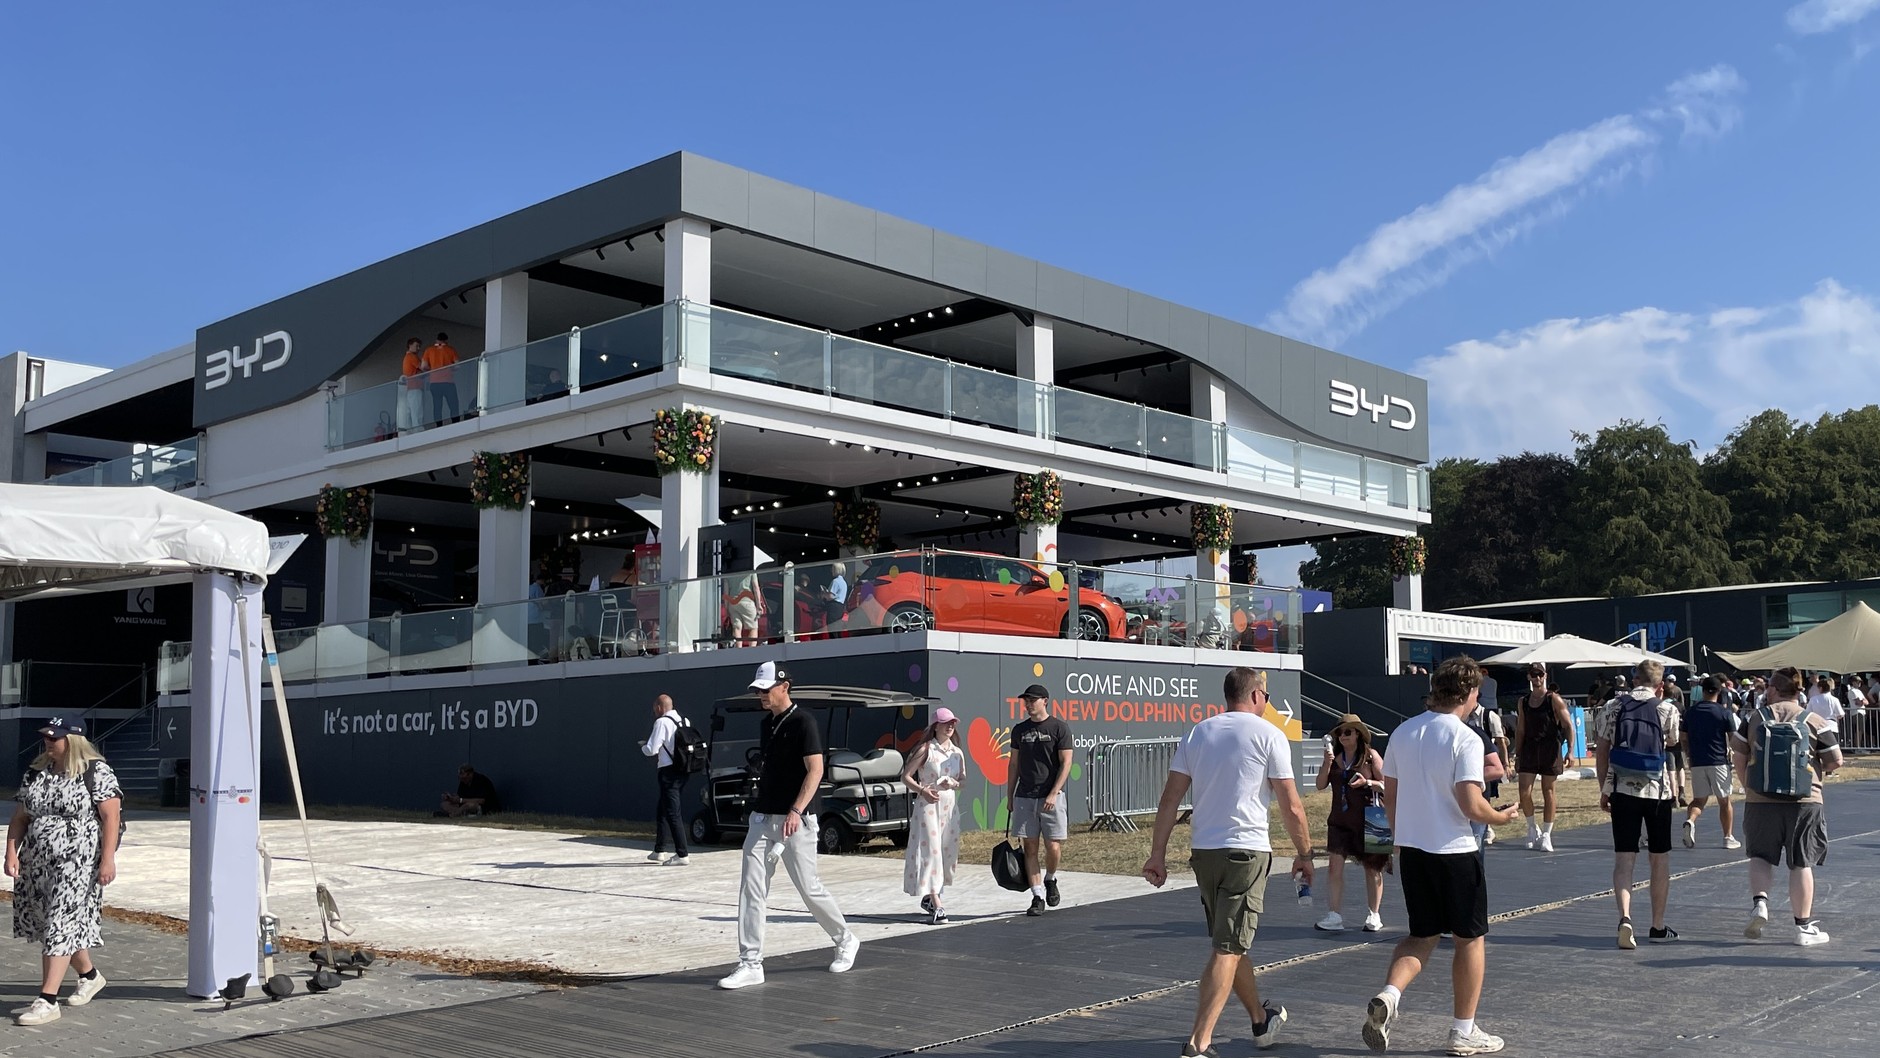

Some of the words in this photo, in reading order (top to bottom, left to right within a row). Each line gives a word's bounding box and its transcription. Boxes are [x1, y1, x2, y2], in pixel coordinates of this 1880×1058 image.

[206, 331, 292, 390] BYD
[1330, 379, 1416, 430] BYD
[375, 541, 438, 565] YD
[113, 616, 166, 625] YANGWANG
[1066, 672, 1122, 696] COME
[1126, 676, 1166, 697] AND
[1170, 677, 1198, 698] SEE
[323, 707, 349, 735] It’s
[352, 709, 382, 733] not
[385, 713, 397, 732] a
[402, 711, 435, 736] car,
[441, 701, 470, 730] It’s
[475, 709, 488, 729] a
[494, 698, 539, 728] BYD
[1052, 699, 1099, 721] NEW
[1104, 701, 1186, 722] DOLPHIN
[1189, 703, 1203, 723] G
[1071, 734, 1097, 748] lobal
